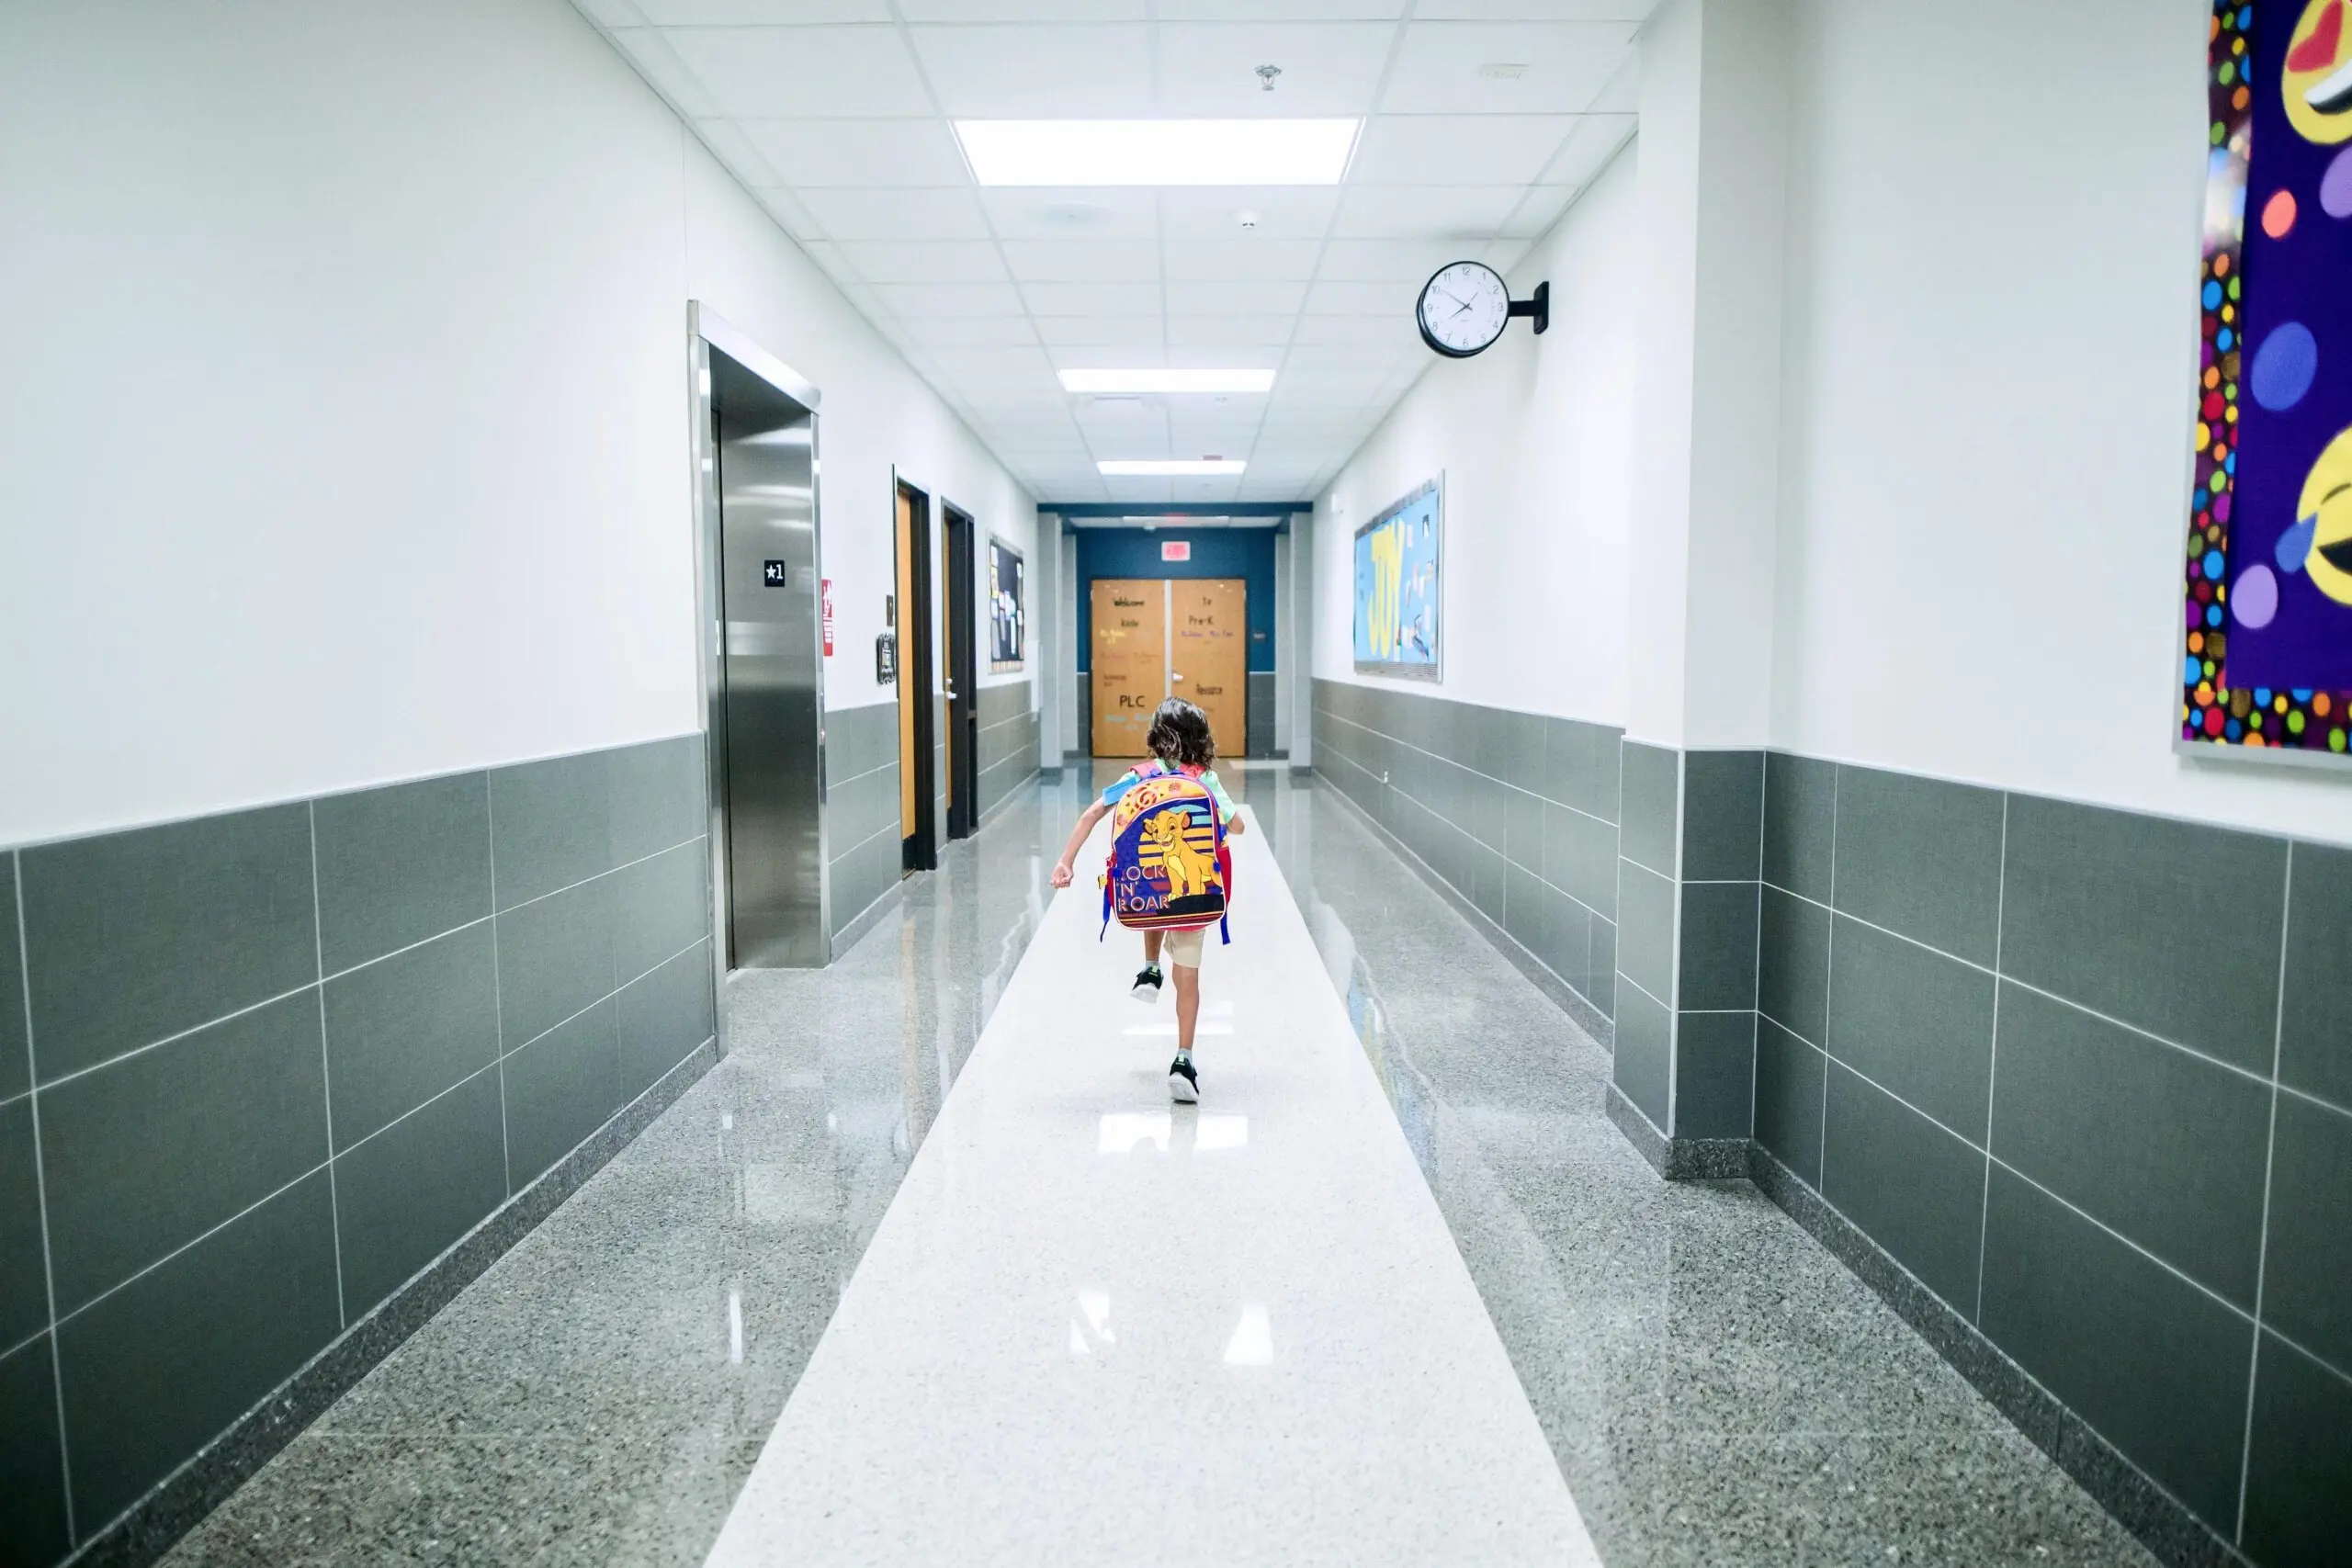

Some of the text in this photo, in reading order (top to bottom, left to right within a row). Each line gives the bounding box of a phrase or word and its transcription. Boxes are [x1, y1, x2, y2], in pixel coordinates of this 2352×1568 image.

[1462, 266, 1470, 276] 12
[1443, 272, 1451, 282] 11
[1431, 285, 1440, 294] 10
[1493, 286, 1499, 295] 2
[1427, 303, 1433, 313] 9
[1498, 303, 1504, 312] 3
[1432, 321, 1439, 332] 8
[1493, 321, 1498, 330] 4
[1463, 337, 1469, 347] 6
[1480, 333, 1487, 343] 5
[1368, 516, 1406, 662] JOY
[1189, 615, 1214, 626] Pre-K
[1119, 694, 1146, 708] PLC
[1117, 865, 1165, 882] OCK
[1117, 896, 1170, 912] ROAR
